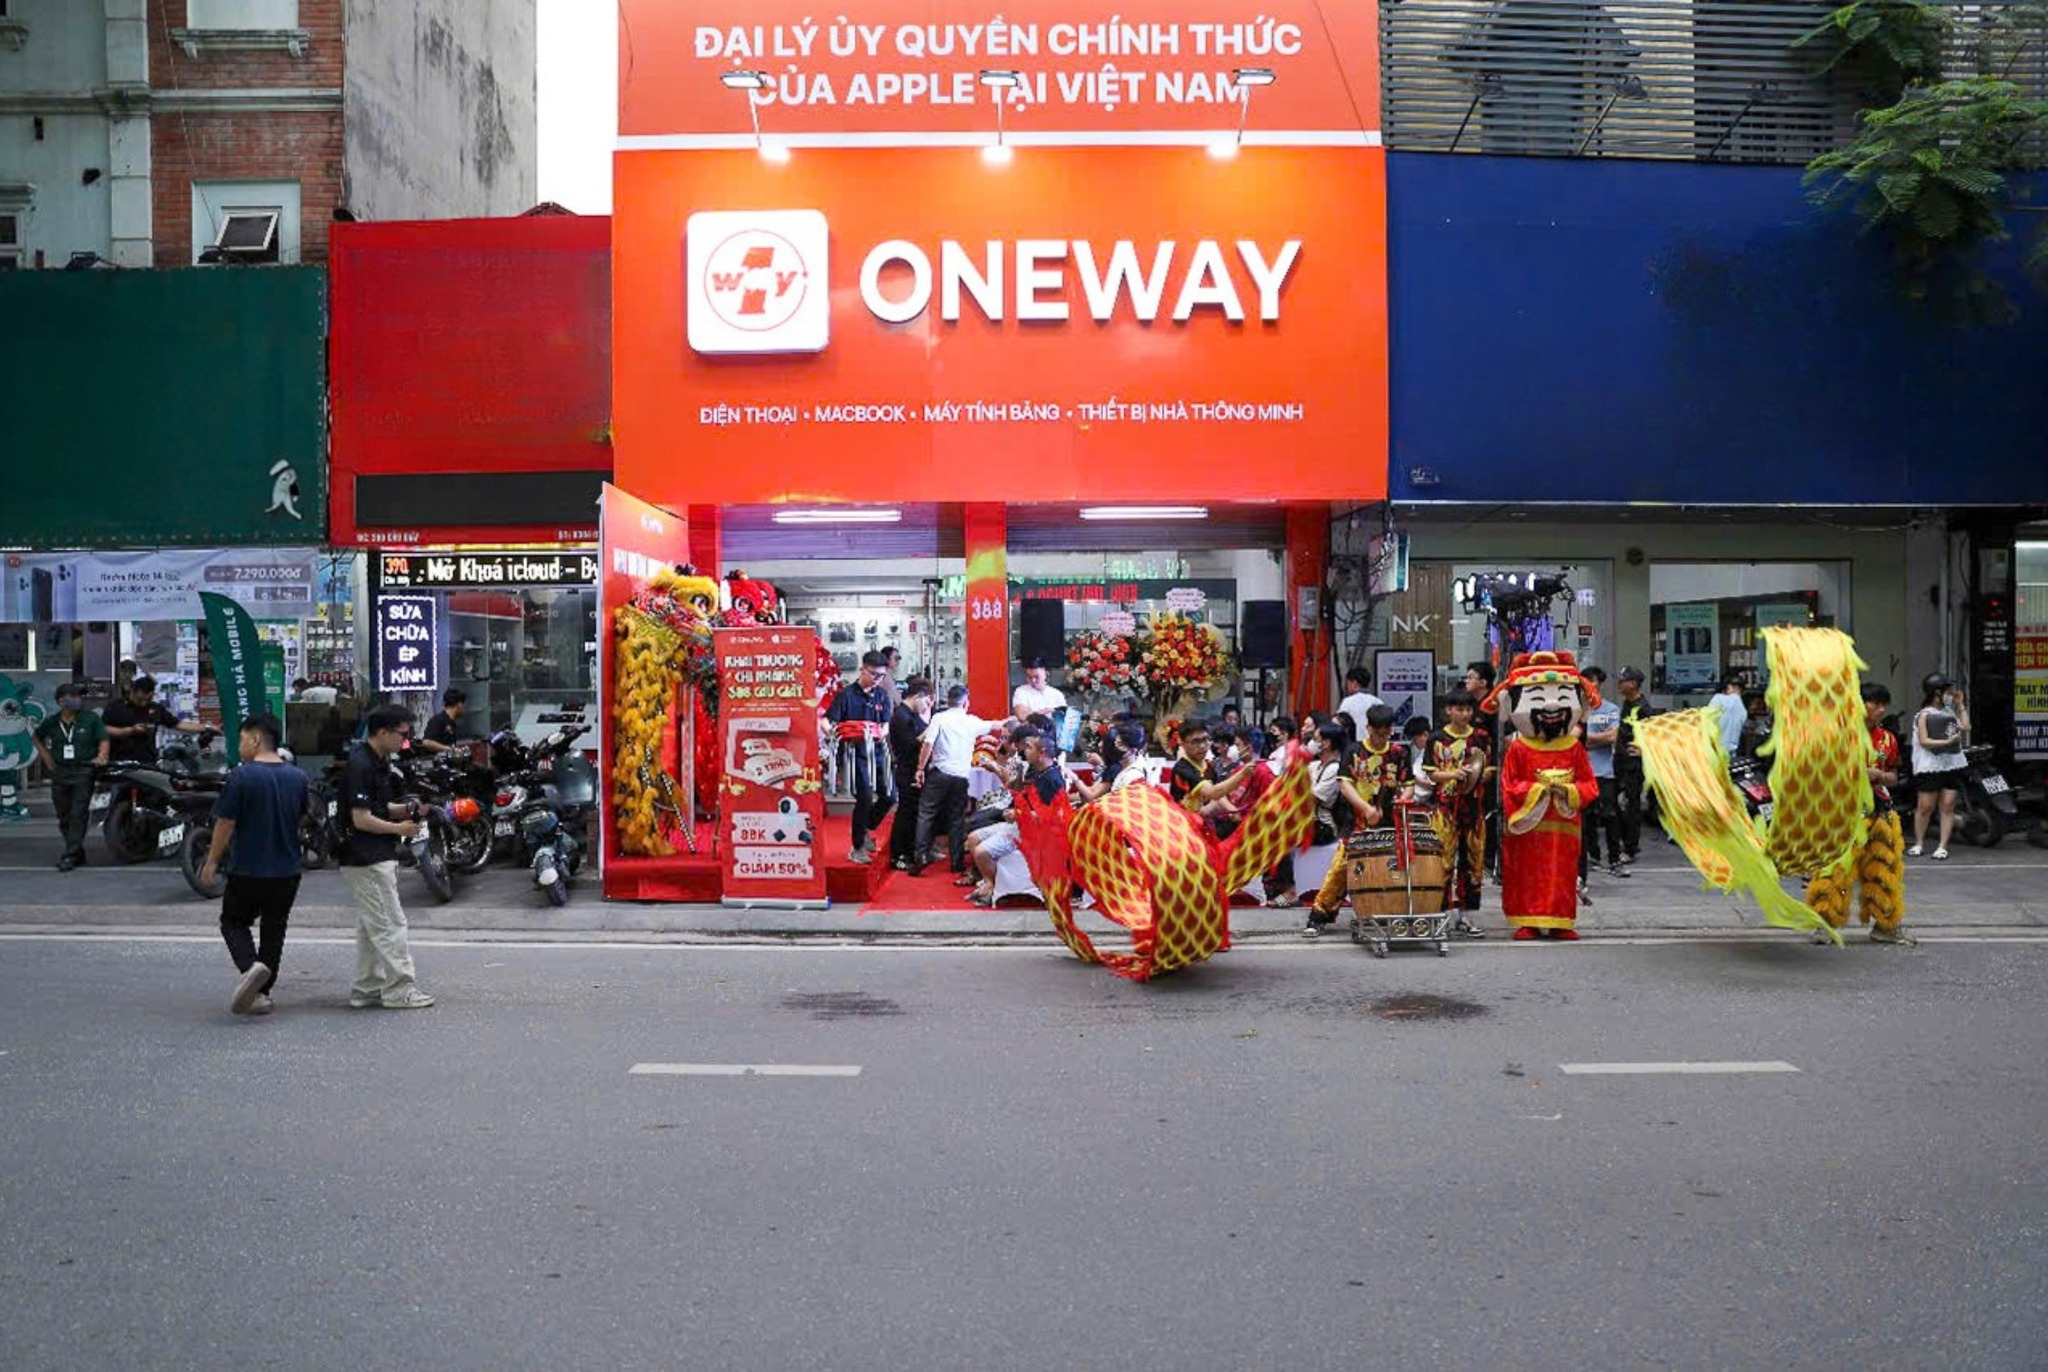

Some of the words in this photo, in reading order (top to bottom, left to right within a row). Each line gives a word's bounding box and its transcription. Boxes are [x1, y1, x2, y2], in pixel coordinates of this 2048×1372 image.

[694, 26, 763, 66] ĐẠI
[773, 16, 818, 57] LÝ
[829, 15, 886, 57] ỦY
[895, 14, 1039, 58] QUYỀN
[1047, 15, 1179, 55] CHÍNH
[1188, 15, 1302, 55] THỨC
[845, 73, 975, 105] APPLE
[1056, 63, 1146, 112] VIỆT
[860, 239, 1303, 322] ONEWAY
[700, 404, 740, 426] ĐIỆN
[744, 406, 798, 426] THOẠI
[814, 405, 906, 423] MACBOOK
[923, 401, 962, 422] MÁY
[964, 401, 1007, 422] TÍNH
[1010, 401, 1060, 421] BẢNG
[1077, 397, 1127, 420] THIẾT
[1130, 404, 1147, 422] BỊ
[1150, 400, 1188, 420] NHÀ
[1191, 400, 1255, 420] THÔNG
[1258, 404, 1304, 420] MINH
[460, 556, 504, 584] Khoá
[389, 602, 423, 620] SỬA
[970, 600, 1003, 621] 388
[222, 606, 243, 661] MOBILE
[385, 623, 430, 641] CHỮA
[231, 664, 246, 685] HÀ
[390, 666, 427, 684] KÍNH
